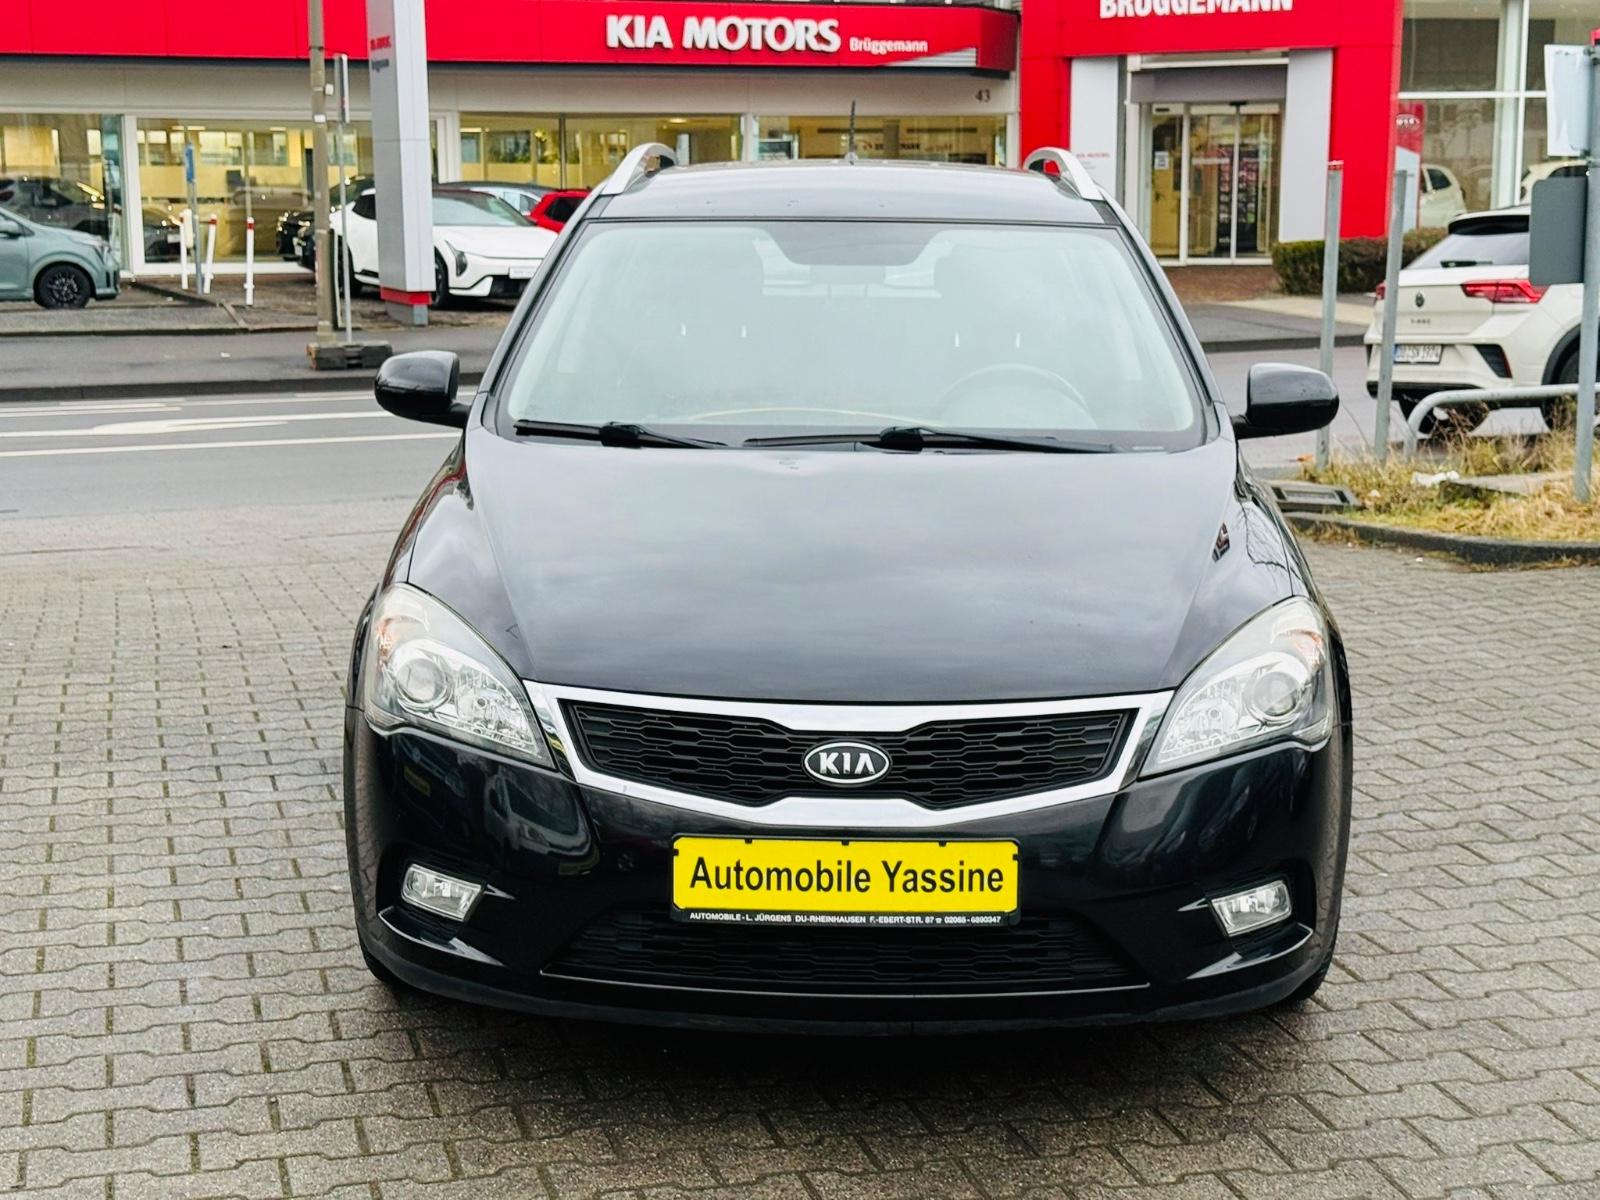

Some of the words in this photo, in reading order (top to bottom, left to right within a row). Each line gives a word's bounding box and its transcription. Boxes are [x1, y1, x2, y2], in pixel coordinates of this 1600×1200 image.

[606, 15, 673, 49] KIA
[682, 16, 841, 52] MOTORS
[849, 37, 929, 55] Brüggemann
[976, 89, 991, 102] 43
[818, 752, 876, 775] KIA
[690, 856, 871, 892] Automobile
[881, 860, 1005, 892] Yassine
[754, 911, 792, 923] JÜRGENS
[795, 914, 866, 924] DU-RHEINHAUSEN
